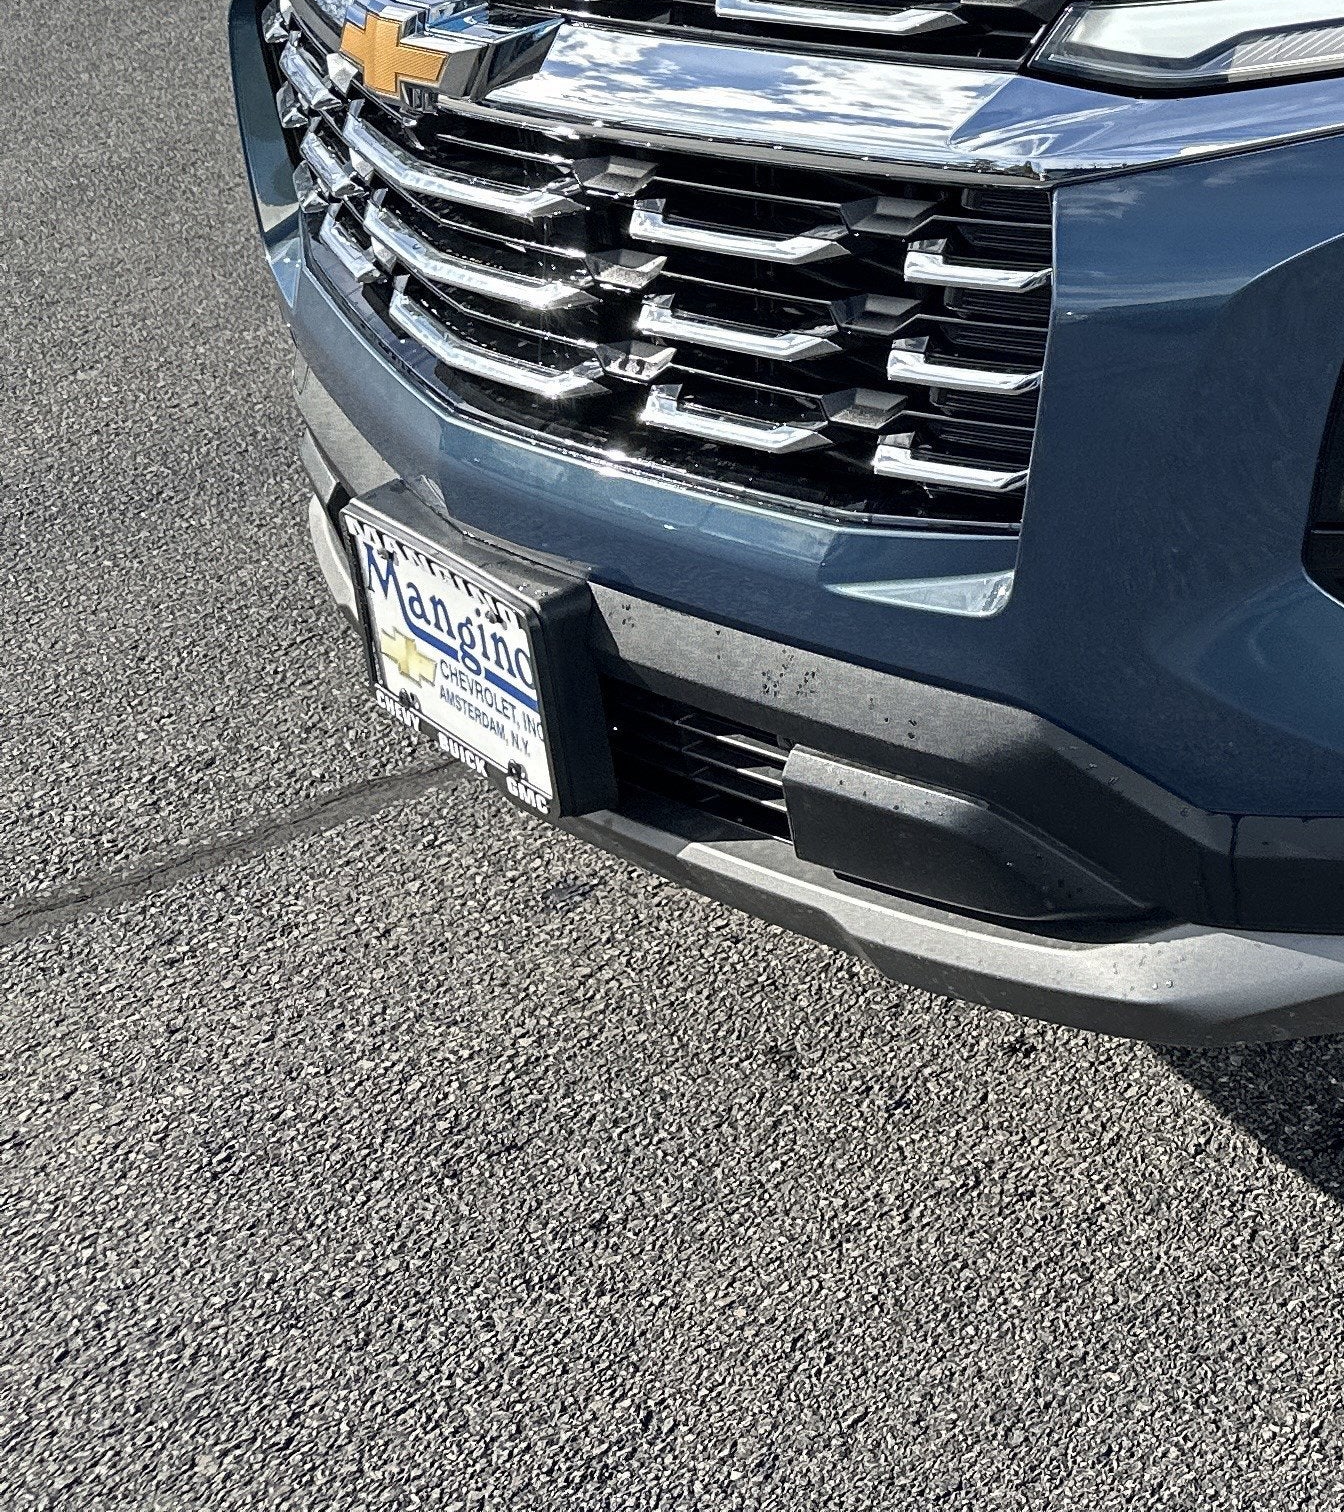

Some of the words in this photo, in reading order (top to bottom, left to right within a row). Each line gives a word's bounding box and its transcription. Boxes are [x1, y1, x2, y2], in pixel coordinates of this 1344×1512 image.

[364, 542, 535, 691] Mangino
[376, 690, 421, 731] CHEVY
[439, 688, 508, 747] AMSTERDAM,
[511, 728, 531, 757] N.Y.
[440, 660, 520, 730] CHEVROLET,
[438, 731, 488, 778] BUICK
[506, 776, 549, 815] GMC
